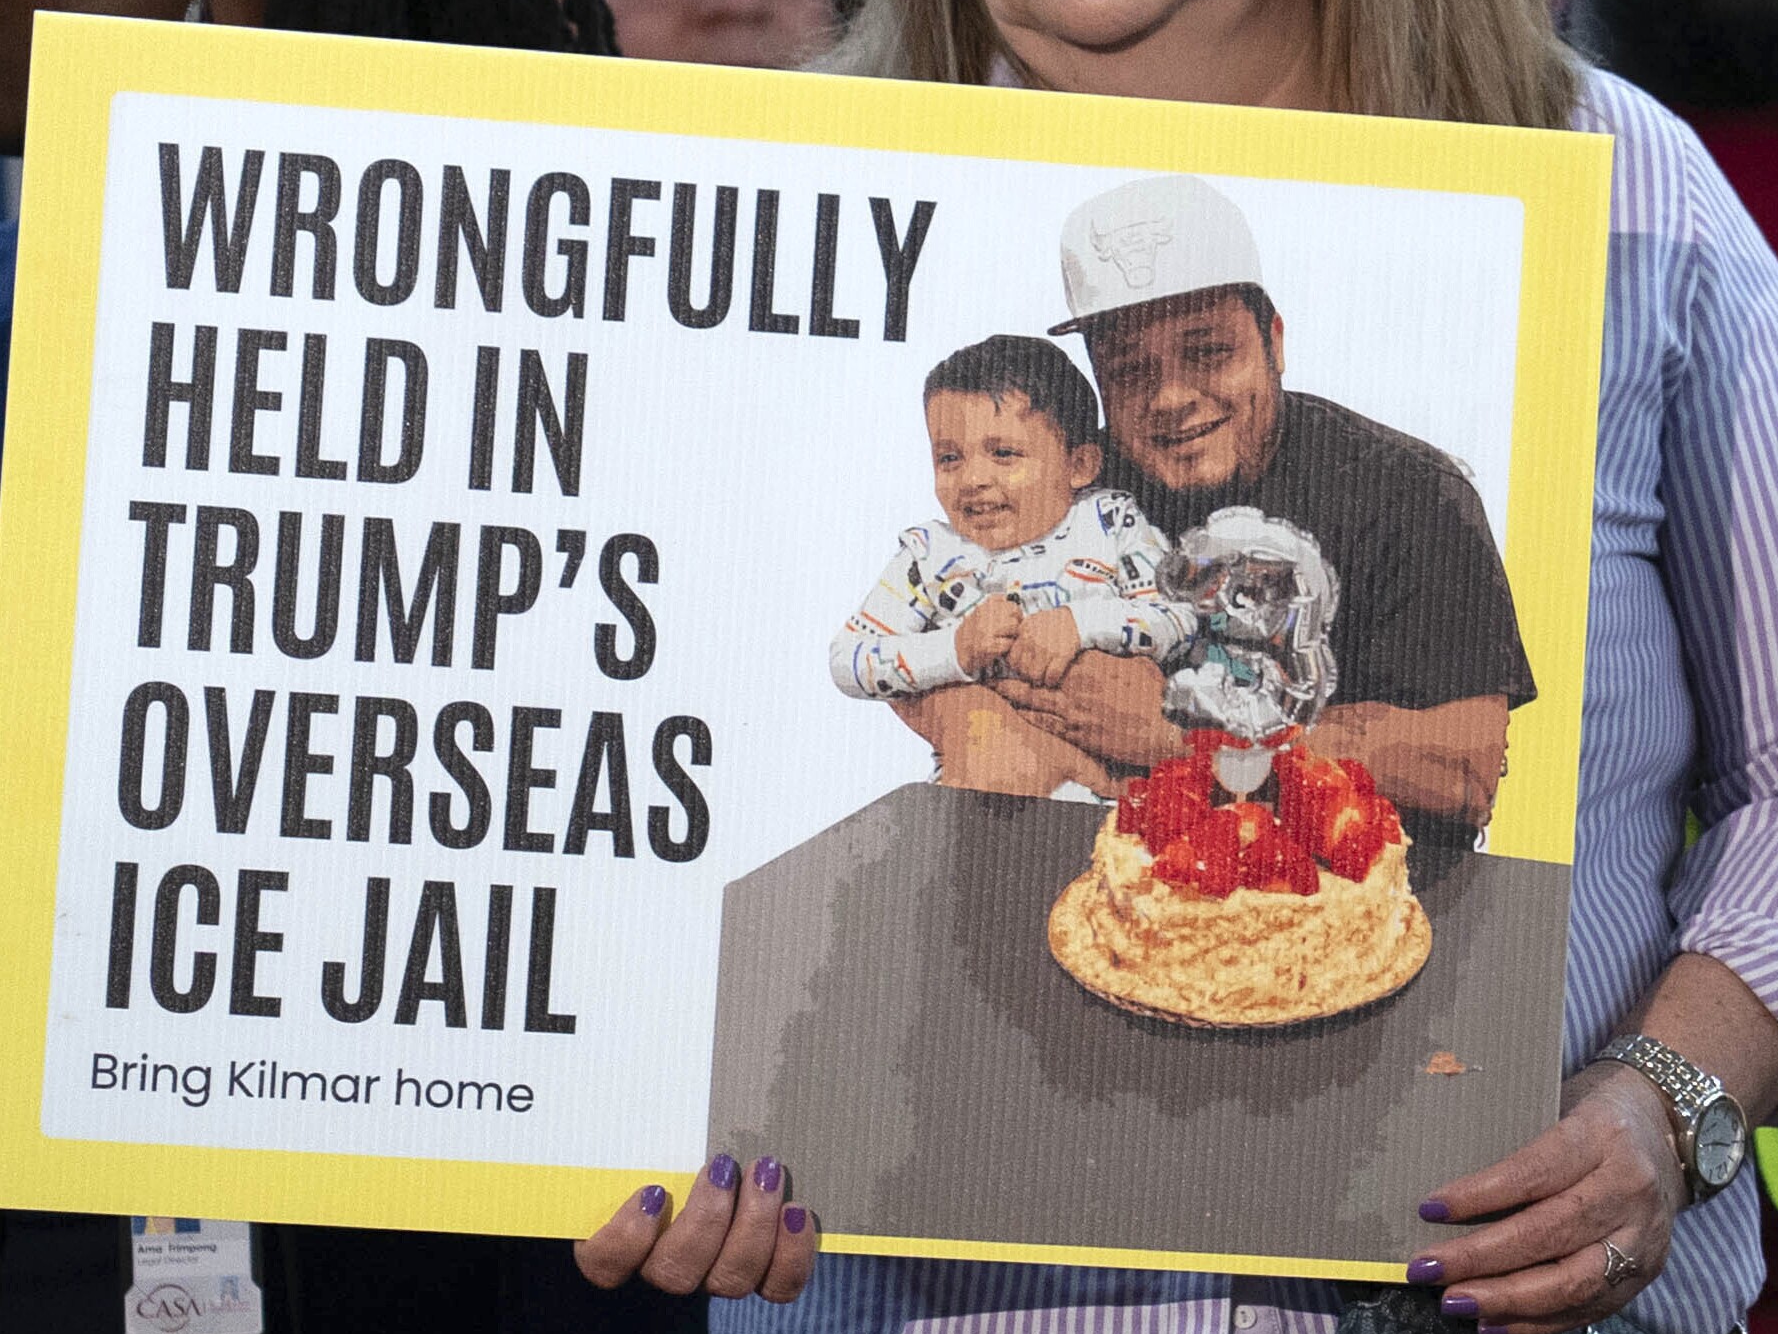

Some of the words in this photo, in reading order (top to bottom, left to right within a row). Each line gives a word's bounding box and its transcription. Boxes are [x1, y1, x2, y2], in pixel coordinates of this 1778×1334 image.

[159, 143, 936, 342] WRONGFULLY
[143, 322, 428, 484] HELD
[469, 346, 587, 496] IN
[129, 501, 659, 680] TRUMP’S
[118, 682, 712, 862] OVERSEAS
[106, 862, 288, 1017] ICE
[321, 877, 576, 1034] JAIL
[91, 1053, 211, 1107] Bring
[229, 1062, 380, 1103] Kilmar
[395, 1069, 534, 1112] home
[137, 1286, 203, 1323] CASA
